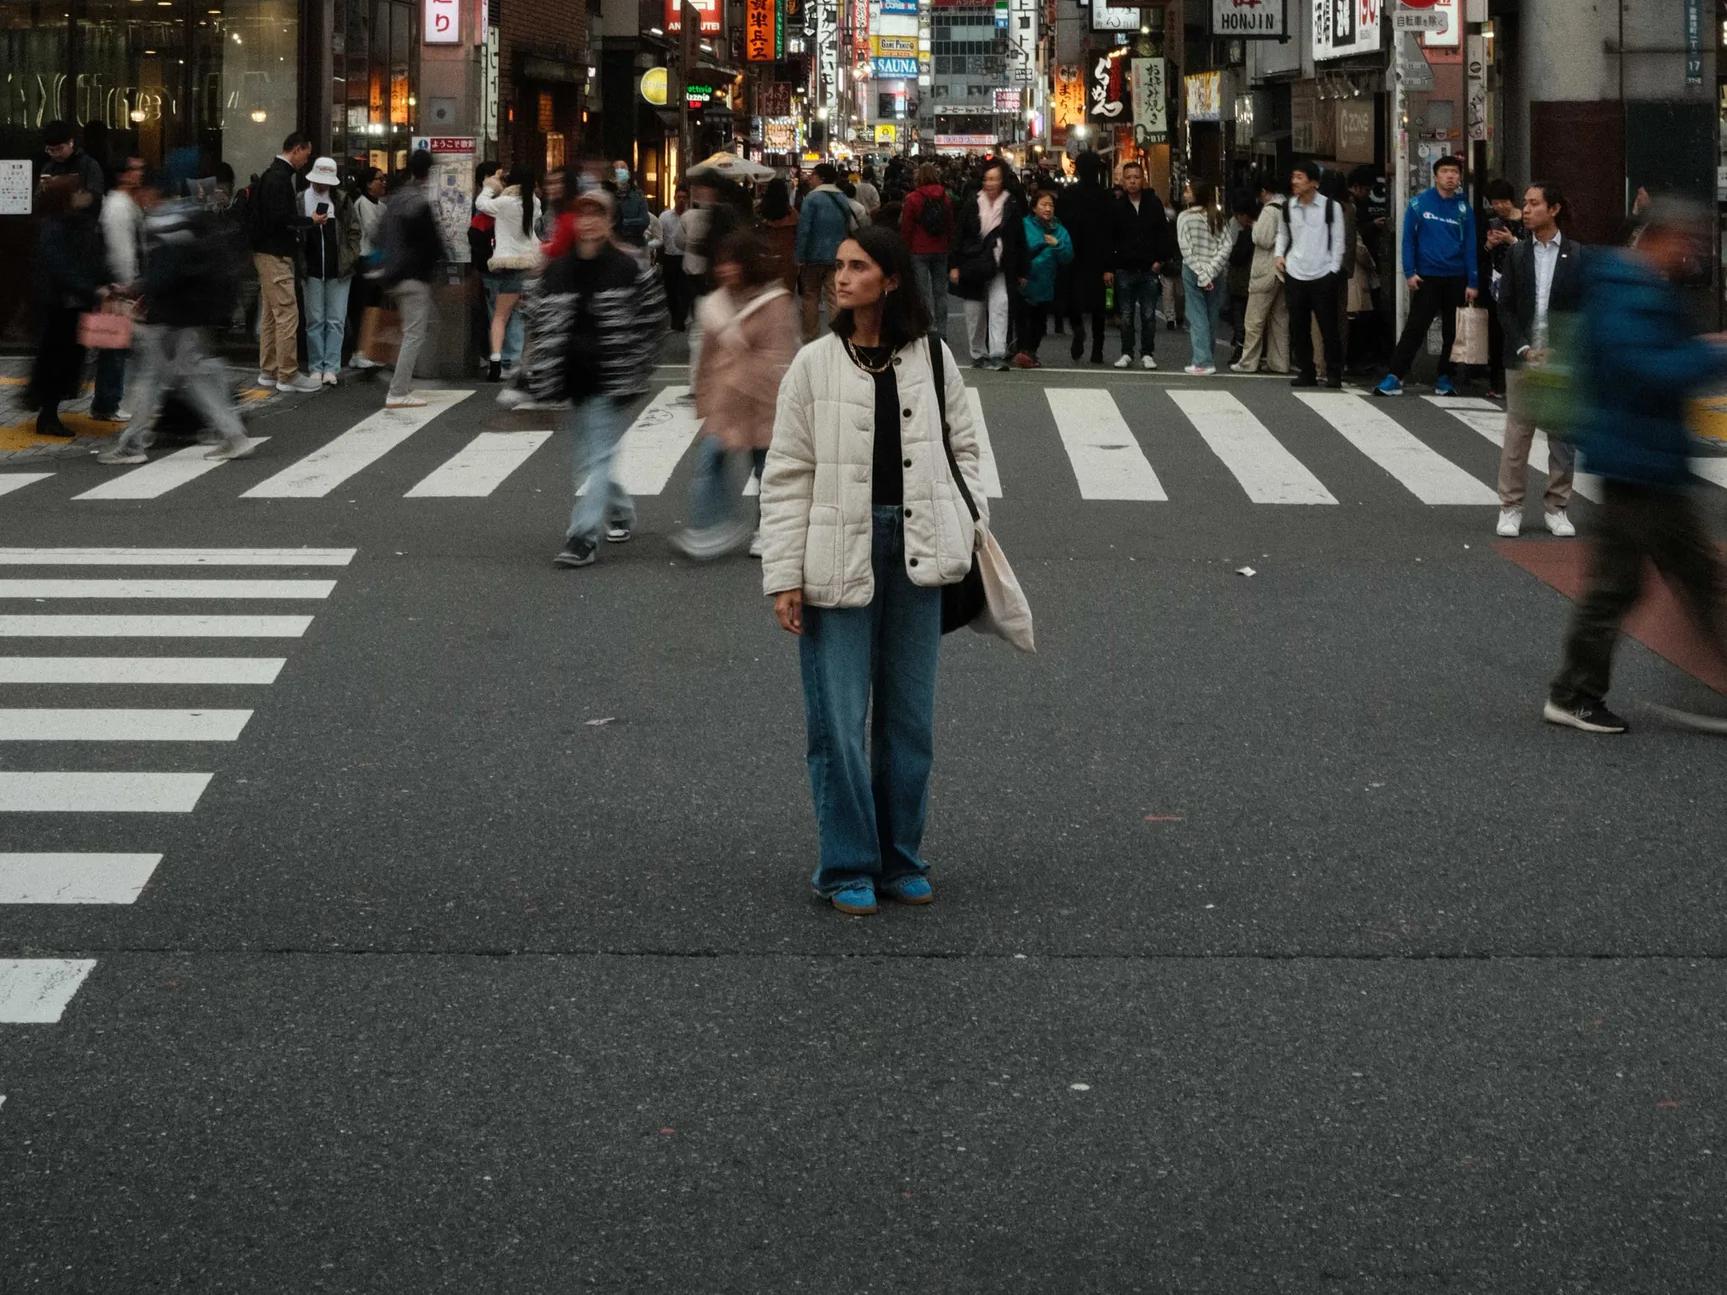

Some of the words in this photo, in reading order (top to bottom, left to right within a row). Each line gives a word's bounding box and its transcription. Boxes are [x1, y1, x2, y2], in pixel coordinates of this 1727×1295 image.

[667, 21, 721, 32] ANUTEI
[1221, 11, 1275, 31] HONJIN
[1396, 14, 1443, 28] 自転車を除く
[877, 58, 918, 74] SAUNA
[1688, 60, 1701, 72] 17
